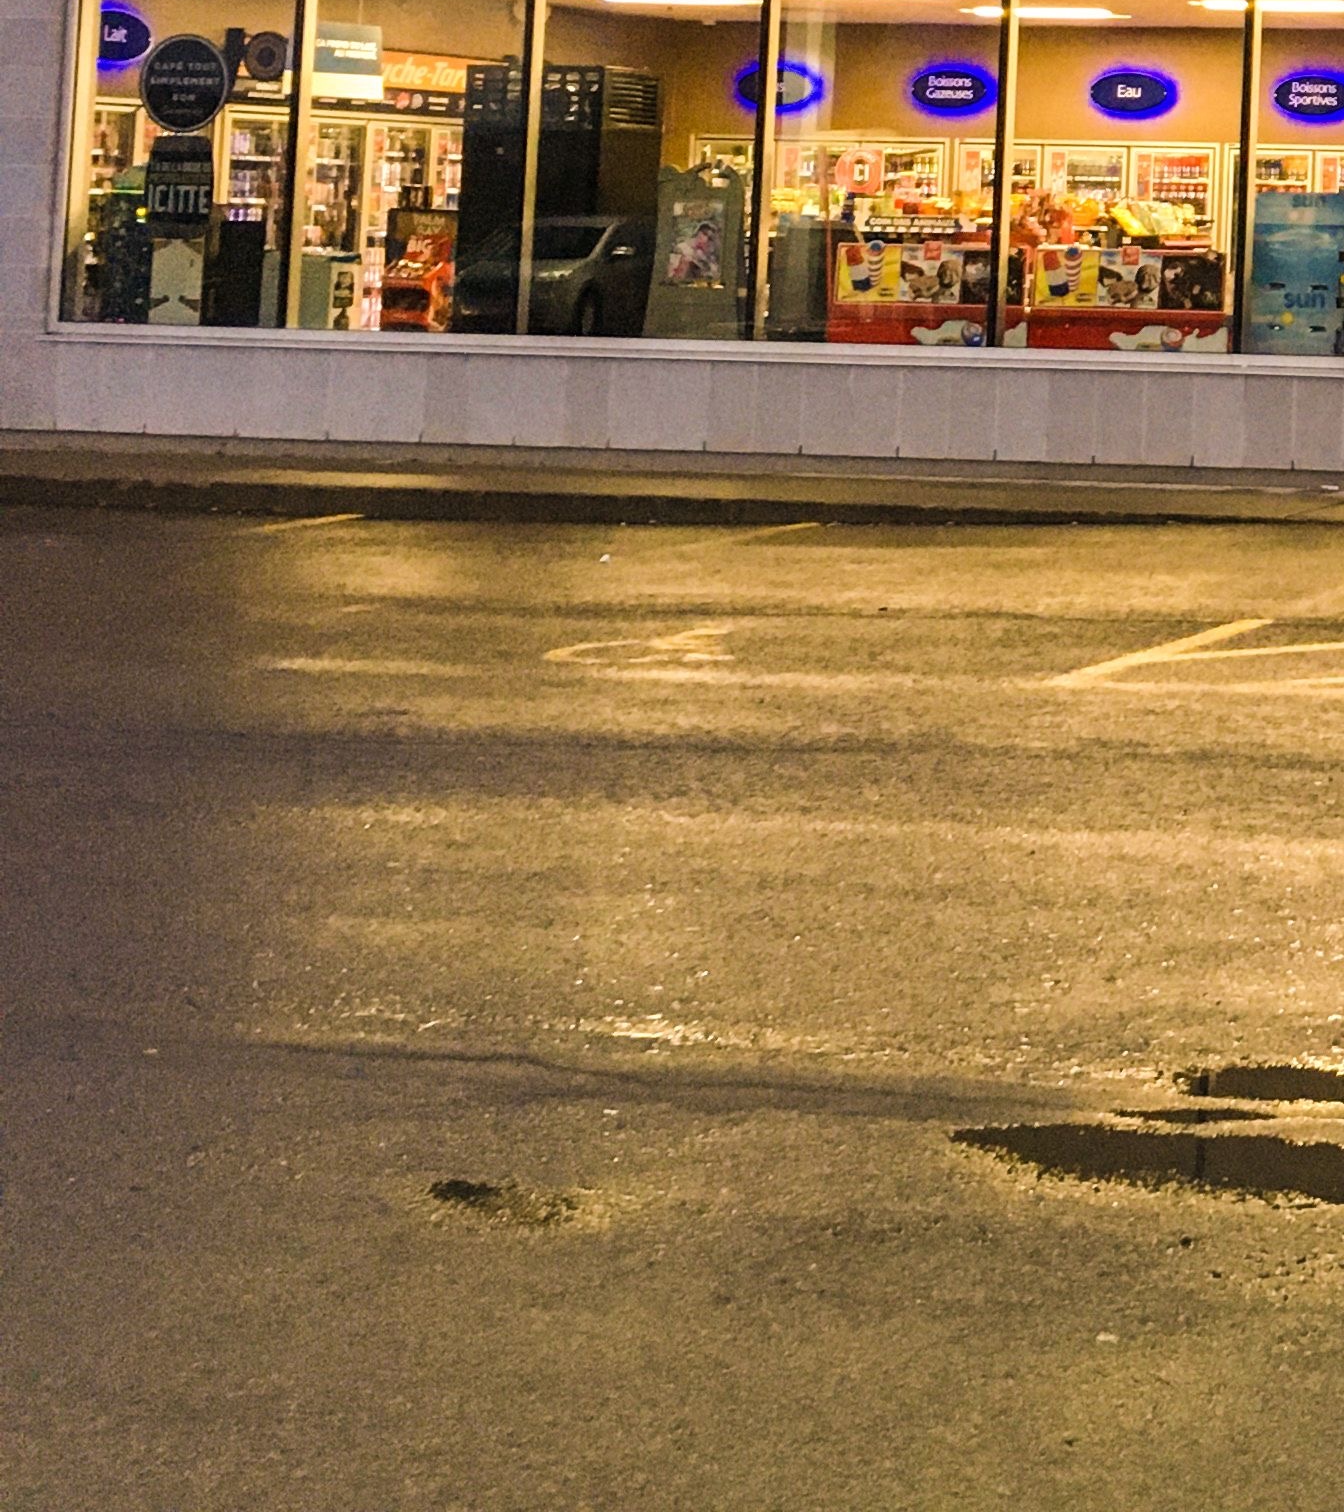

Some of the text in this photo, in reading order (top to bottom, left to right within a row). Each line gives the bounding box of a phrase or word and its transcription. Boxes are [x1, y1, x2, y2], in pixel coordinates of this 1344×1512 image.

[103, 24, 128, 43] Lait
[382, 56, 466, 90] uche-Tar
[928, 75, 973, 87] Boissons
[1291, 81, 1337, 94] Boissons
[1117, 84, 1142, 98] Eau
[1288, 93, 1338, 108] Sportives
[148, 184, 210, 214] ICITTE
